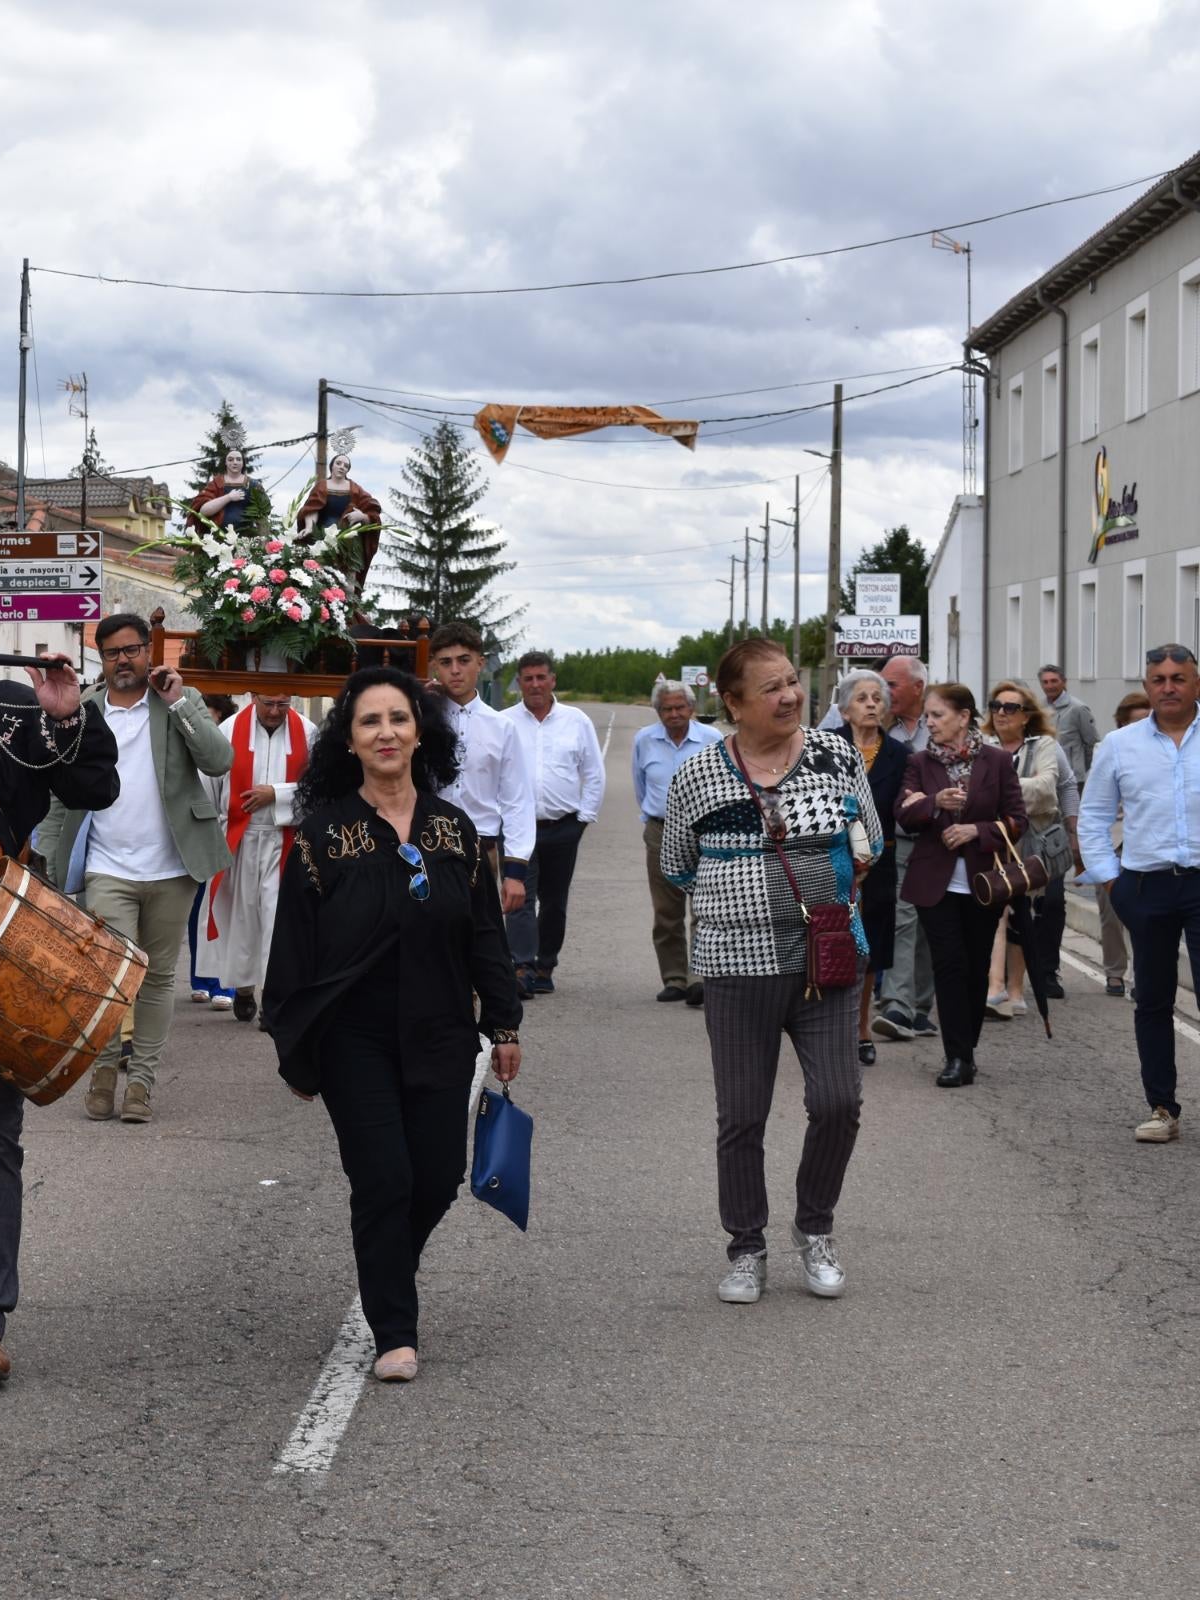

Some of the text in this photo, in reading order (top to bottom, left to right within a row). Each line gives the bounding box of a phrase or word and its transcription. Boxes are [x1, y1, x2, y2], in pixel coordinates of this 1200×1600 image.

[29, 567, 64, 575] mayores
[9, 578, 56, 588] despiece
[860, 618, 895, 627] BAR
[839, 629, 917, 640] RESTAURANTE
[839, 645, 849, 654] El
